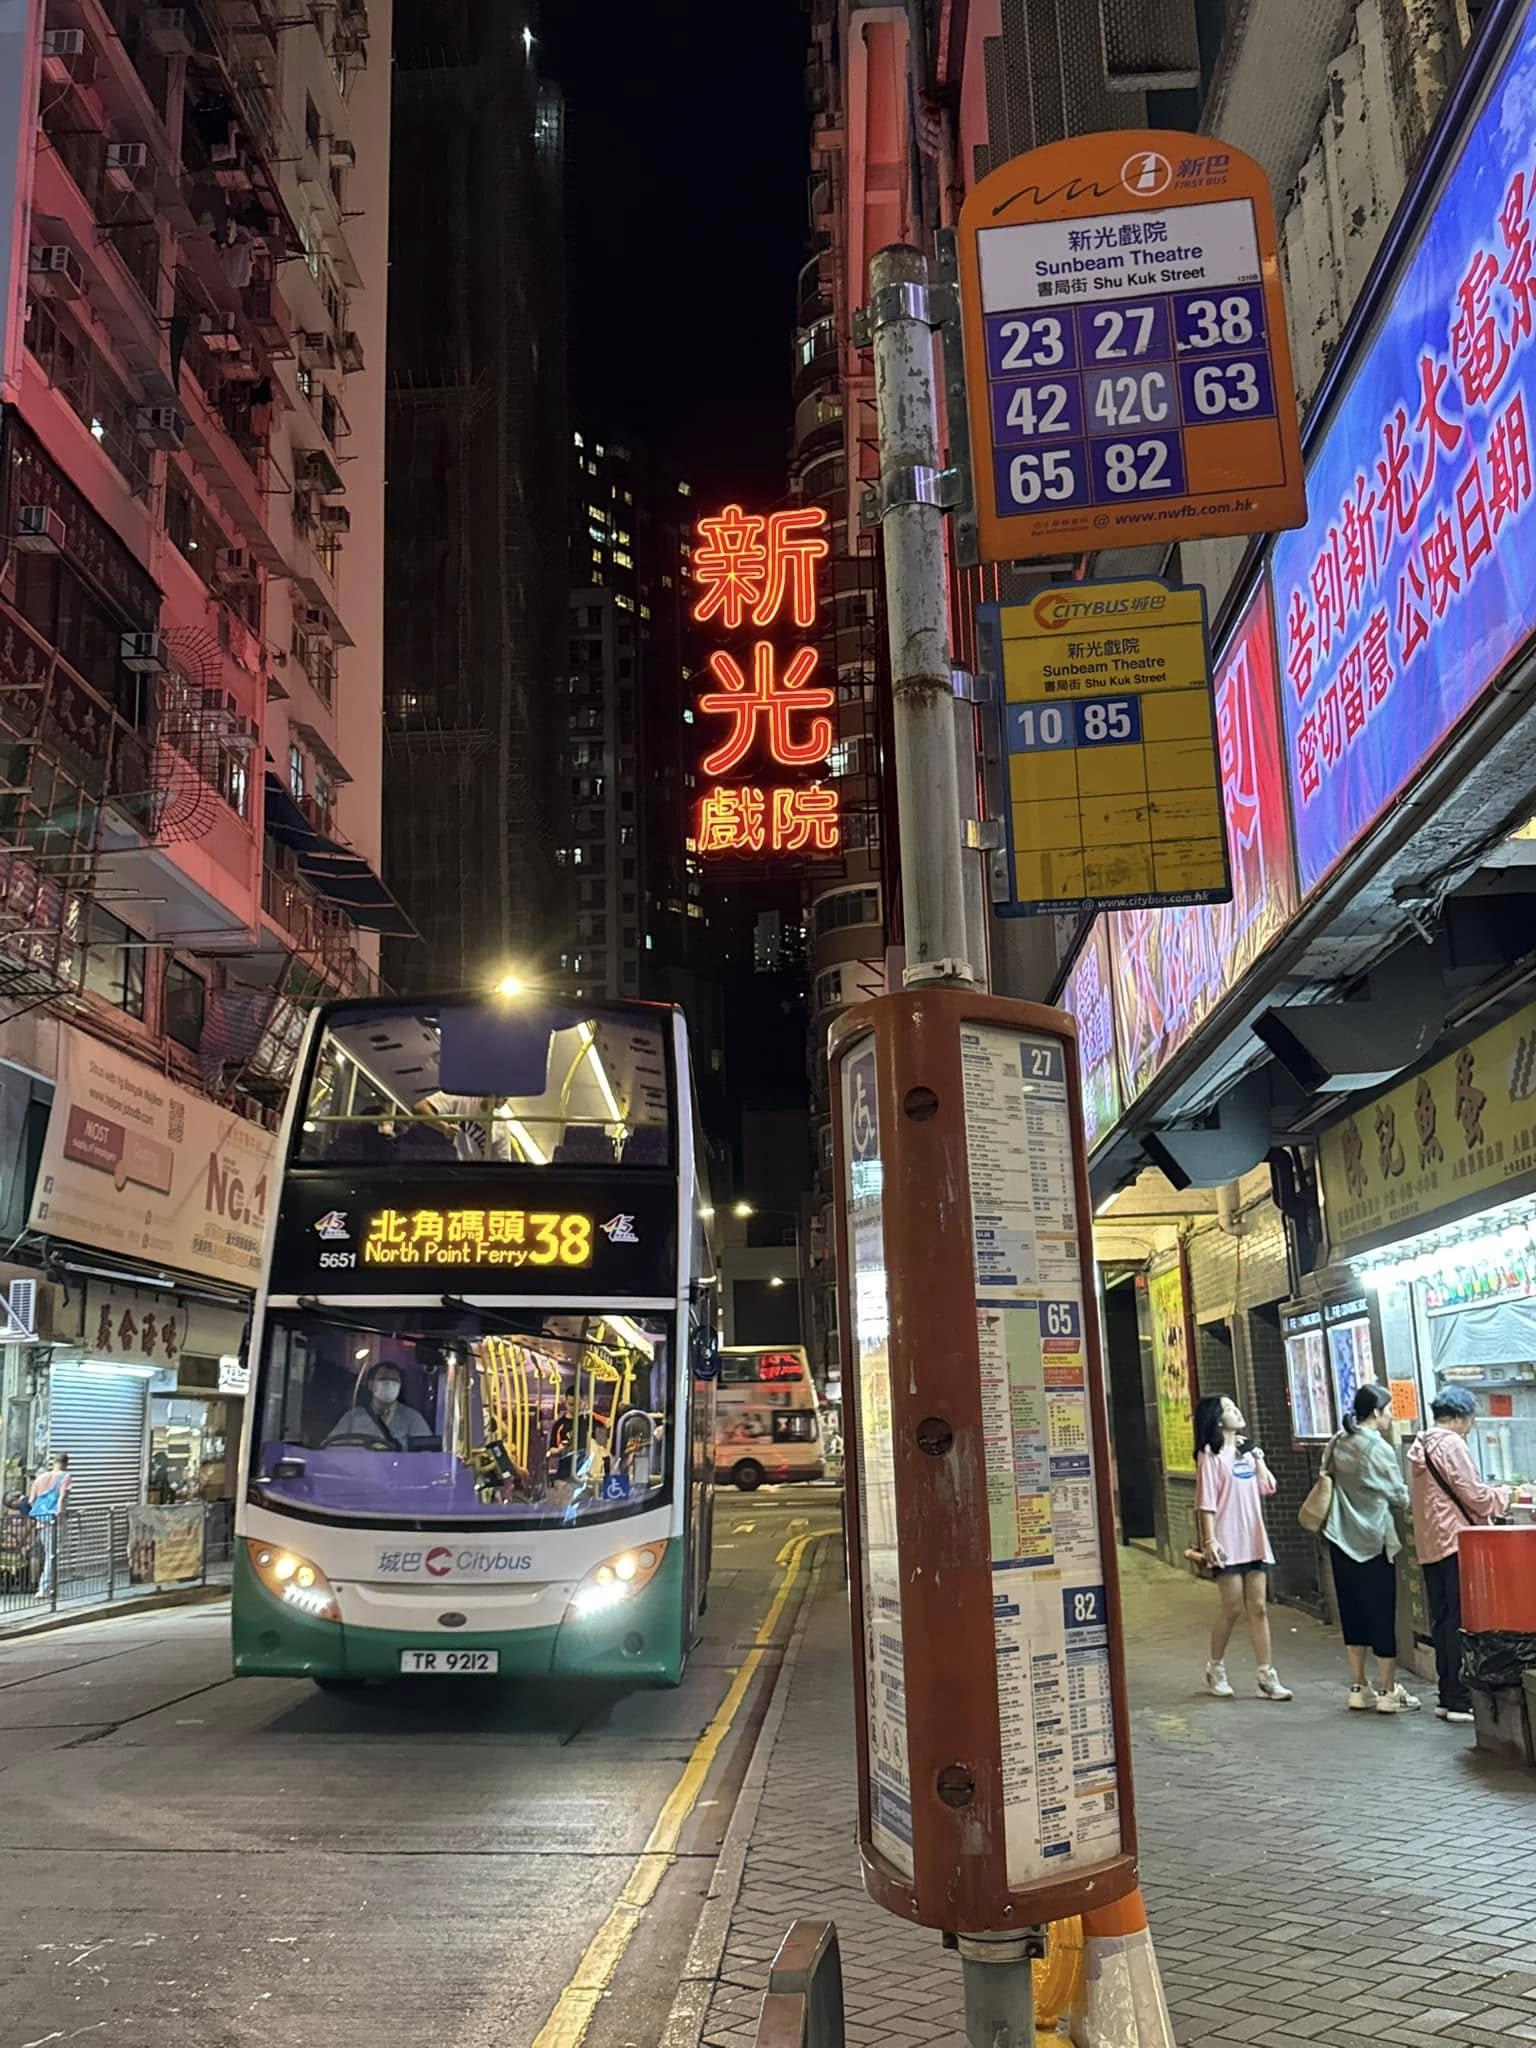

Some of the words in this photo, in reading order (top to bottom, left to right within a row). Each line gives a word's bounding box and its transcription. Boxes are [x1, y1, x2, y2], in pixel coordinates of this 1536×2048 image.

[1176, 155, 1230, 178] 新巴
[1205, 175, 1227, 186] BUS
[1067, 221, 1168, 252] 新光戲院
[1035, 254, 1124, 276] Sunbeam
[1129, 246, 1203, 266] Theatre
[1037, 278, 1088, 297] 書局街
[1093, 277, 1123, 290] Shu
[1127, 272, 1156, 287] Kuk
[1160, 267, 1206, 283] Street
[1000, 317, 1064, 371] 23
[1093, 306, 1155, 361] 27
[1186, 296, 1253, 349] 38
[1006, 384, 1070, 436] 42
[1095, 371, 1168, 427] 42C
[1193, 362, 1260, 416] 63
[1009, 450, 1074, 505] 65
[1104, 439, 1171, 494] 82
[1115, 498, 1254, 525] www.nwfb.com.hk
[1053, 599, 1129, 618] CITYBUS
[1131, 595, 1166, 611] 城巴
[1298, 606, 1394, 802] 密切留意
[1396, 389, 1533, 667] 公映日期
[1067, 637, 1140, 660] 新光戲院
[1043, 661, 1108, 677] Sunbeam
[1112, 656, 1165, 672] Theatre
[1044, 678, 1080, 693] 書局街
[1085, 677, 1106, 688] Shu
[1109, 675, 1130, 686] Kuk
[1134, 672, 1167, 684] Street
[1017, 707, 1063, 745] 10
[1084, 702, 1131, 741] 85
[697, 786, 839, 852] 戲院
[1098, 891, 1209, 908] www.citybus.com.hk
[1031, 1048, 1053, 1077] 27
[369, 1209, 526, 1242] 北角碼頭
[529, 1214, 592, 1264] 38
[319, 1252, 356, 1268] 5651
[365, 1241, 419, 1263] North
[423, 1241, 471, 1263] Point
[476, 1241, 528, 1267] Ferry
[1047, 1303, 1072, 1335] 65
[378, 1552, 421, 1573] 城巴
[456, 1551, 532, 1573] Citybus
[1073, 1591, 1097, 1622] 82
[413, 1653, 437, 1670] TR
[446, 1653, 489, 1670] 9212
